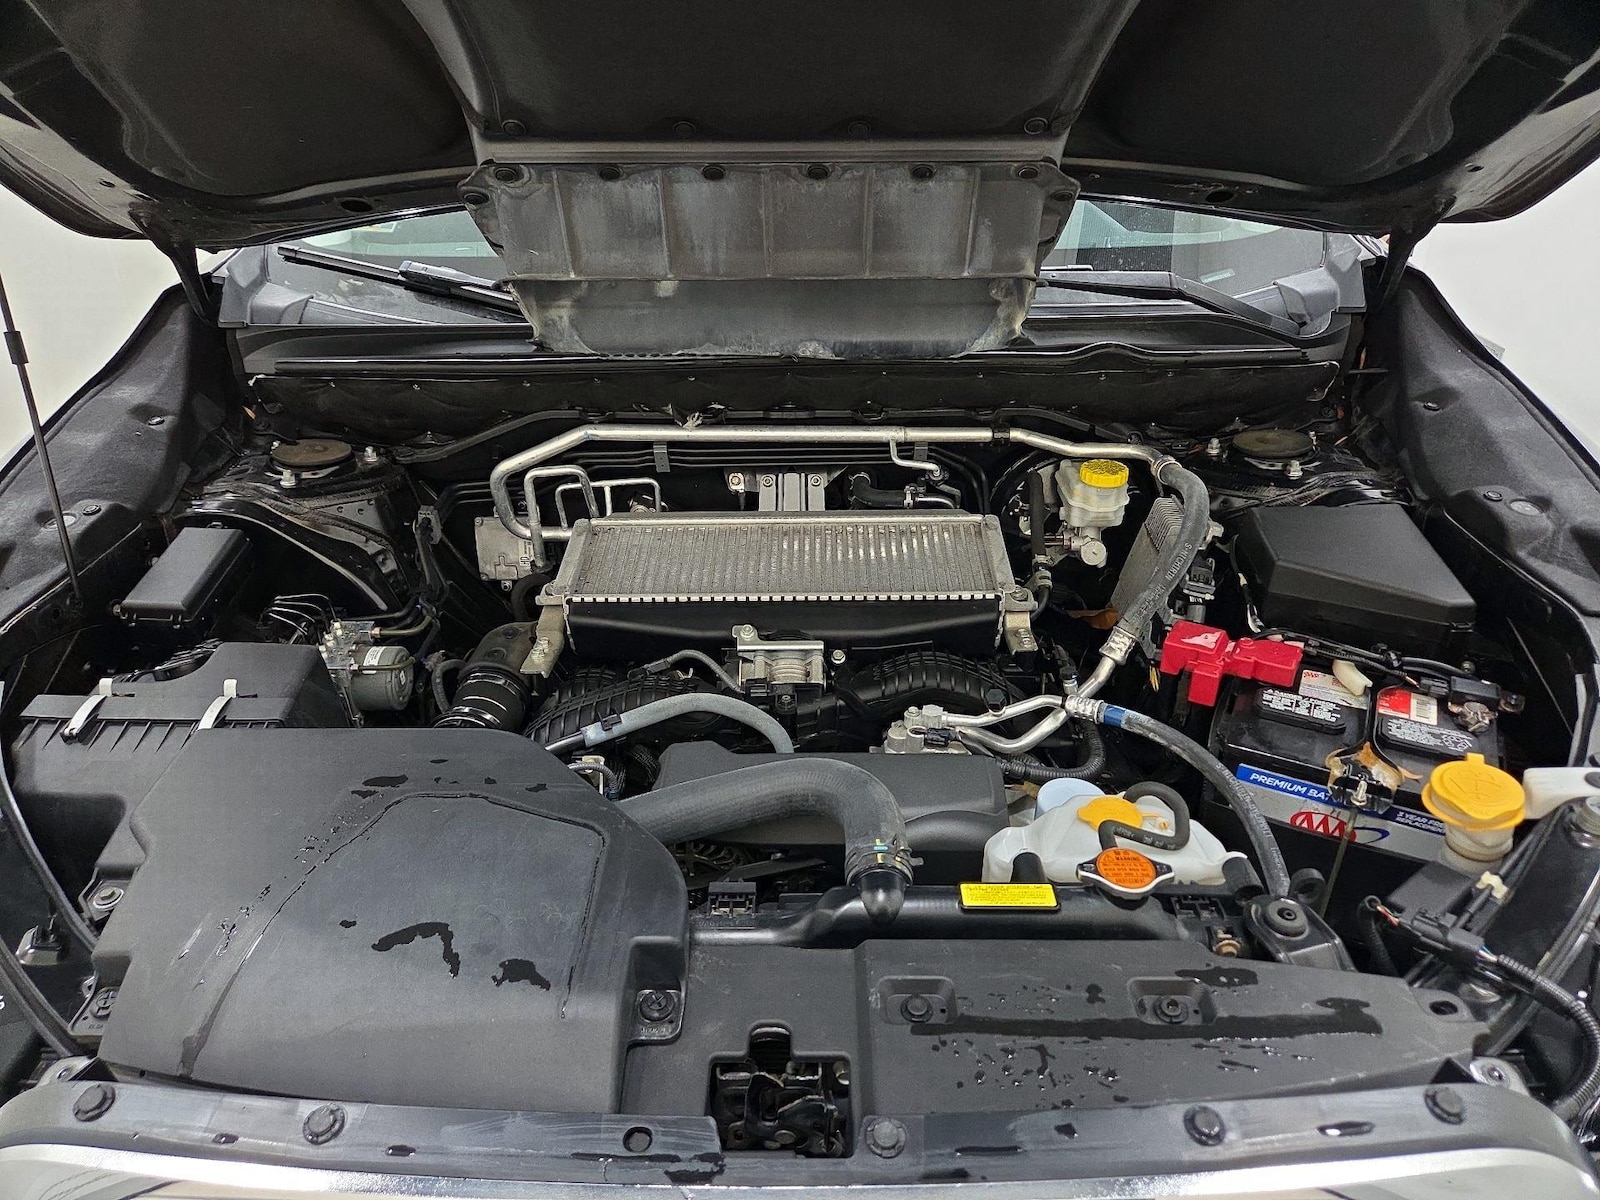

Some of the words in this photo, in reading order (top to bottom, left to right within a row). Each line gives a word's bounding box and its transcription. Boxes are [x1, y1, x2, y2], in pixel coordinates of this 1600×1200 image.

[1250, 773, 1308, 794] PREMIUM
[1307, 788, 1331, 801] BAT
[1405, 813, 1428, 823] YEAR
[1428, 819, 1445, 829] FRE
